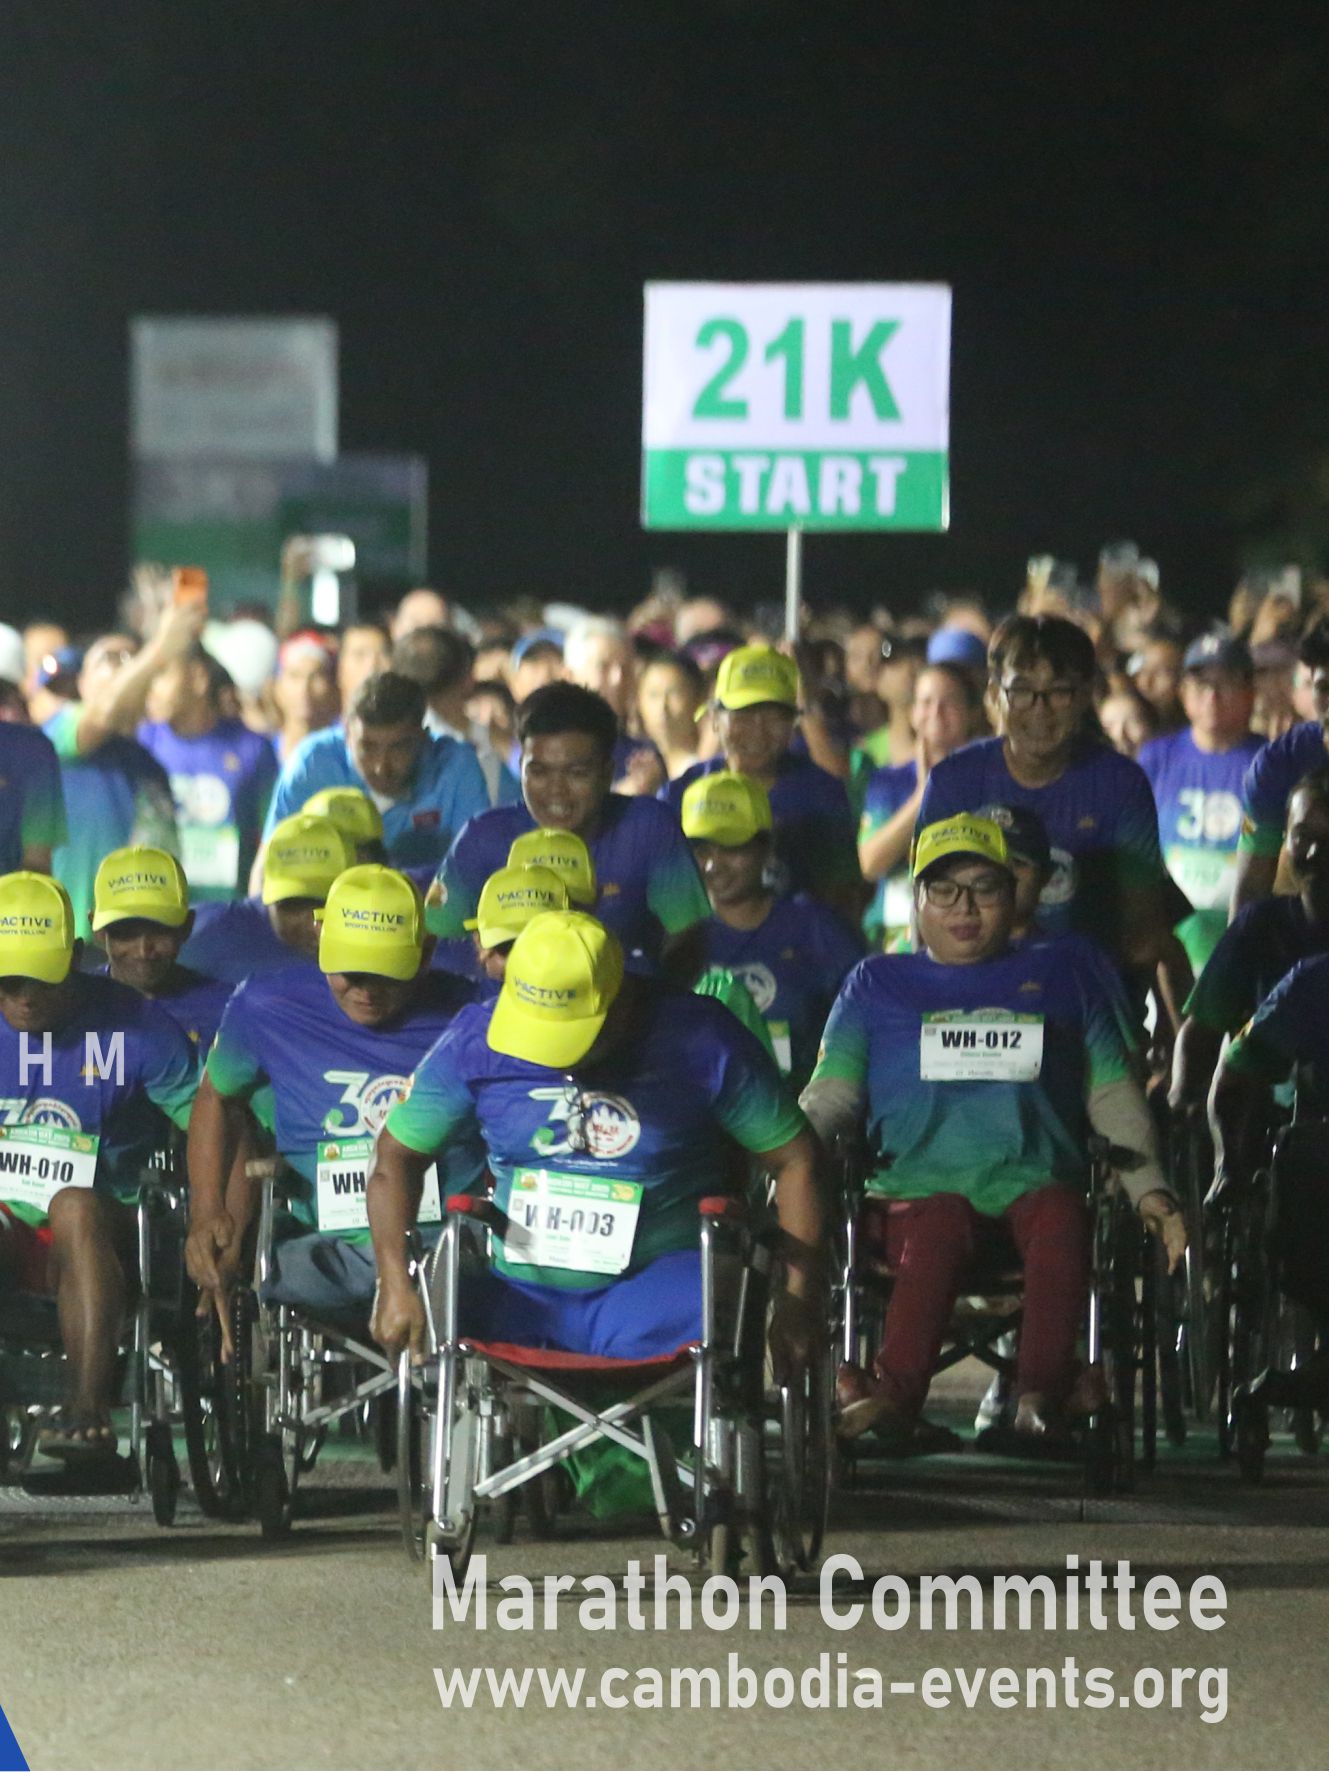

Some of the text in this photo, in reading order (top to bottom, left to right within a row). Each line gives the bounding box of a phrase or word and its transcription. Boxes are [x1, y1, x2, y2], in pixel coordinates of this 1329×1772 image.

[691, 315, 903, 423] 21K
[683, 452, 908, 516] START
[341, 907, 406, 925] V-ACTIVE
[941, 1029, 1023, 1049] WH-012
